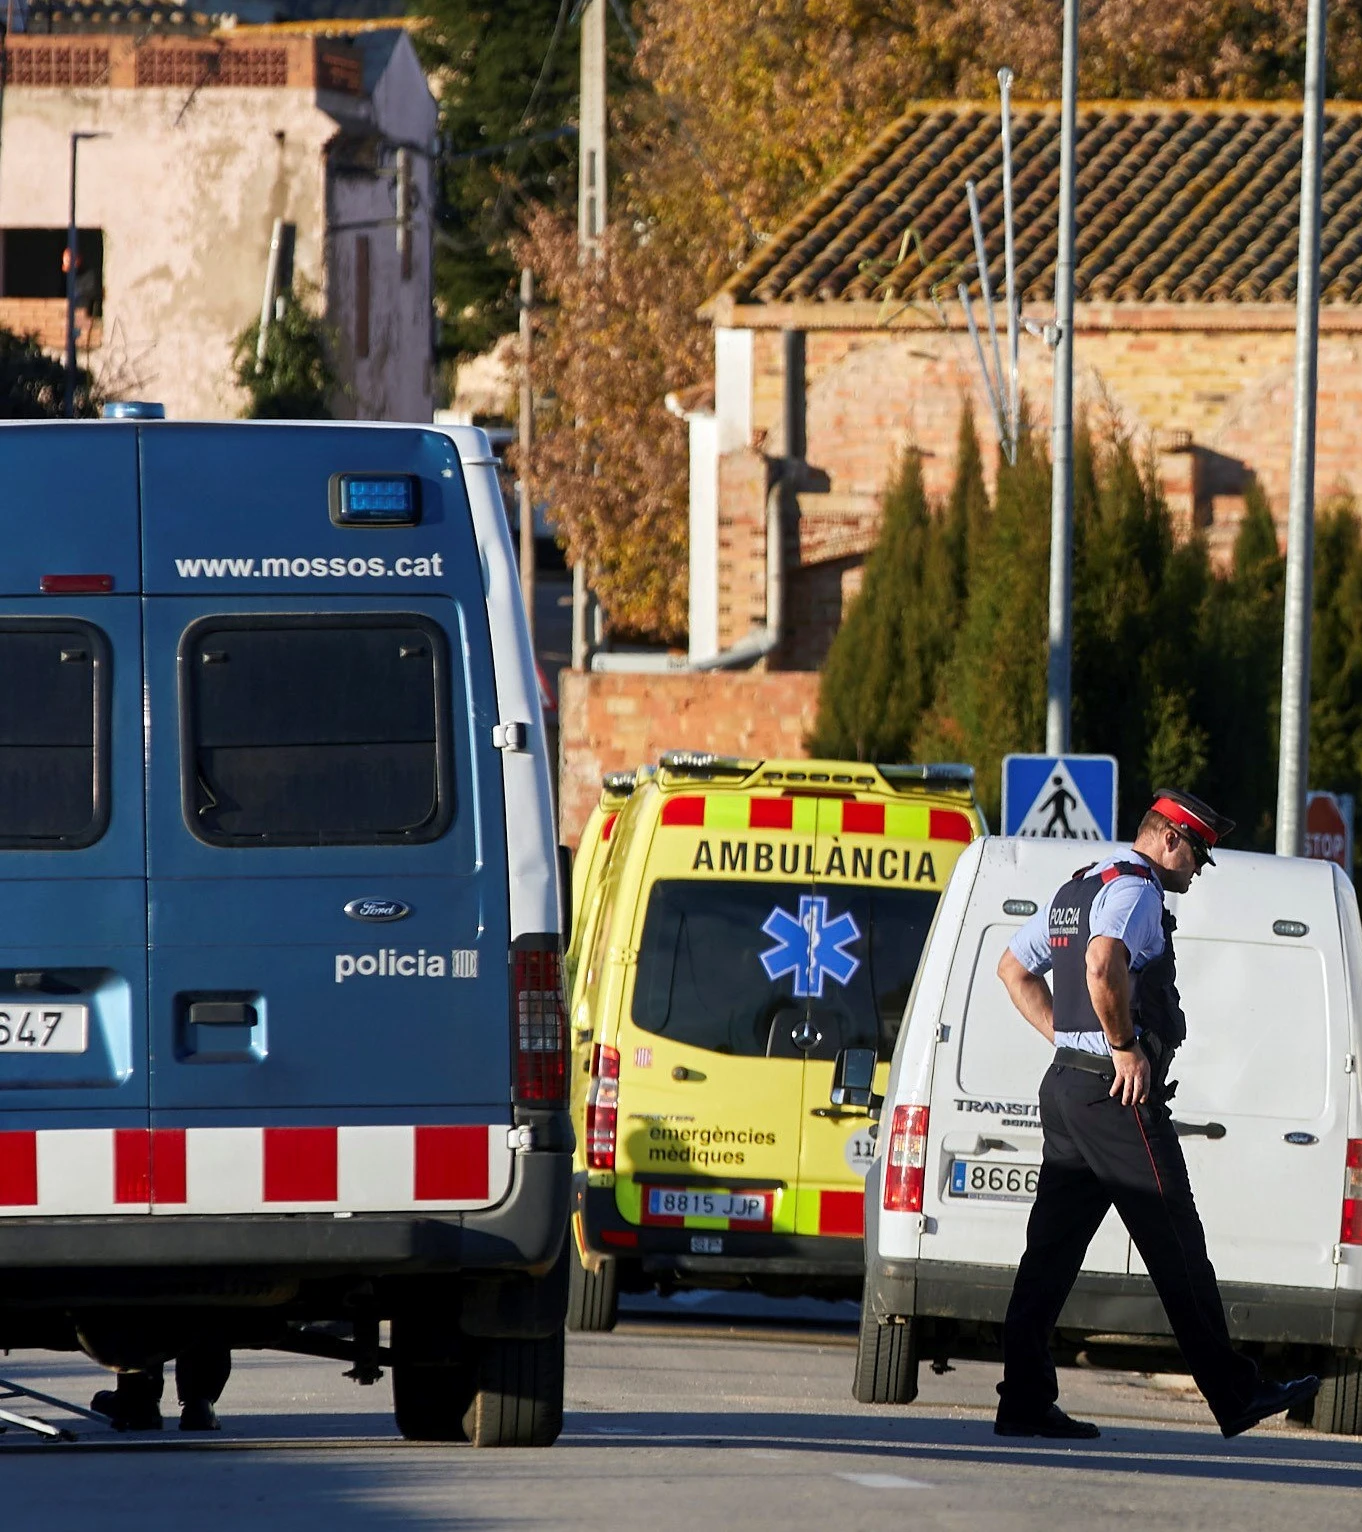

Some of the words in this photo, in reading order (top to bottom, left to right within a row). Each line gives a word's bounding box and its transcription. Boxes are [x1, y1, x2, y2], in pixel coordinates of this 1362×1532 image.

[174, 552, 444, 578] www.mossos.cat
[1304, 832, 1344, 859] STOP
[691, 836, 937, 883] AMBULÀNCIA
[359, 901, 396, 916] Ford
[335, 949, 446, 983] policia
[953, 1099, 1041, 1116] TRANSIT
[650, 1126, 776, 1145] emergències
[649, 1146, 745, 1166] mèdiques
[971, 1166, 1038, 1193] 8666
[664, 1193, 714, 1214] 8815
[722, 1197, 760, 1217] JJP
